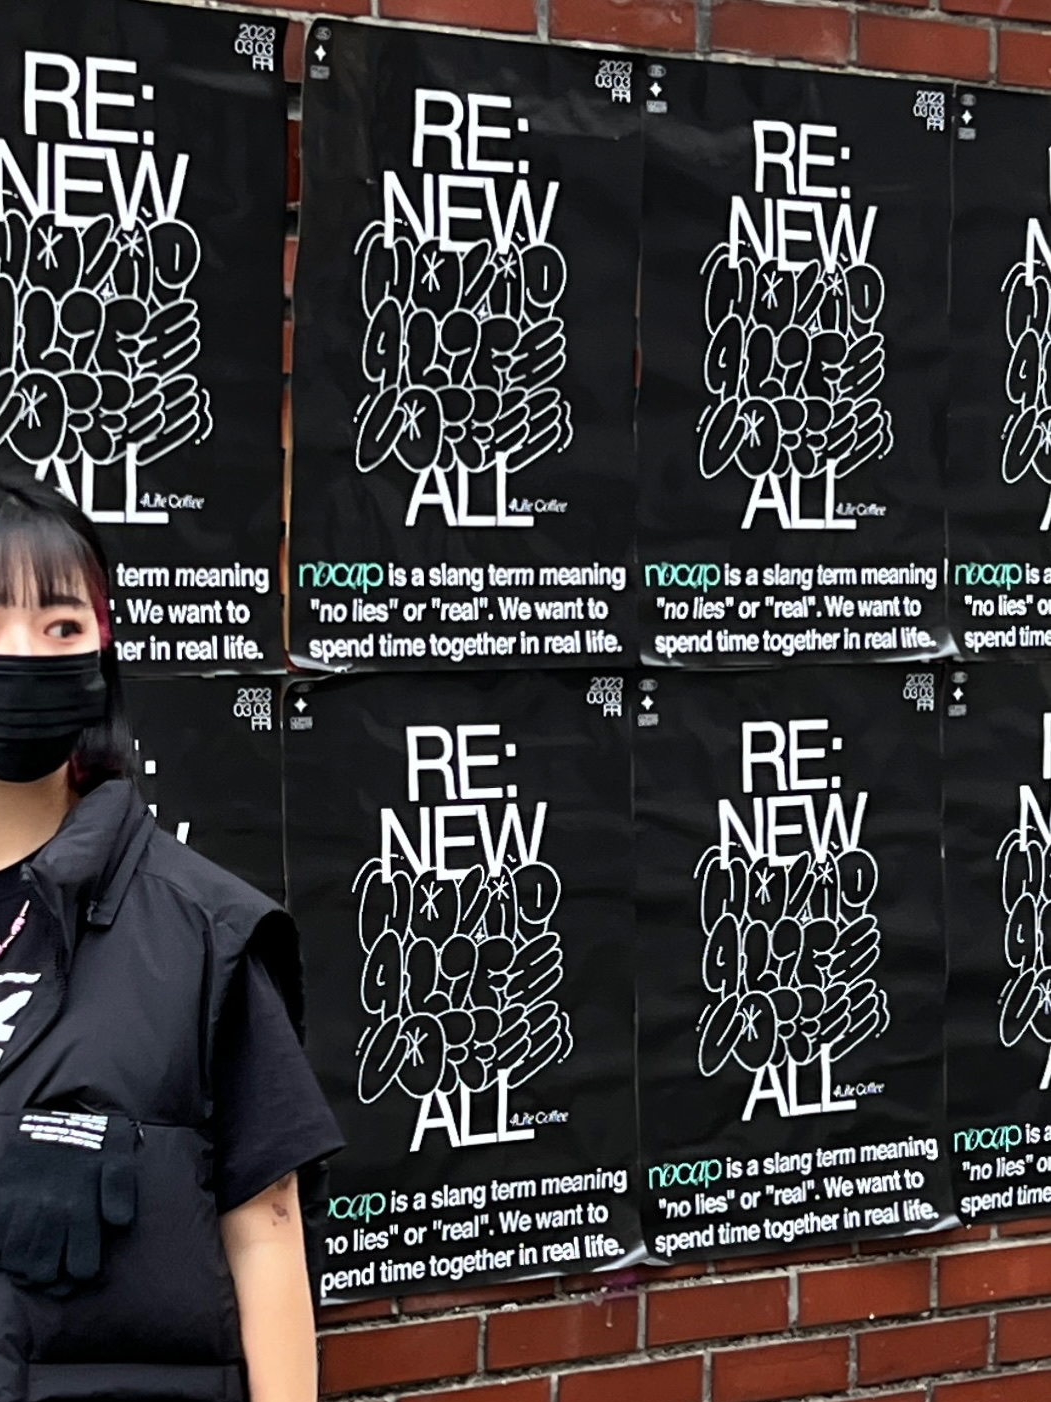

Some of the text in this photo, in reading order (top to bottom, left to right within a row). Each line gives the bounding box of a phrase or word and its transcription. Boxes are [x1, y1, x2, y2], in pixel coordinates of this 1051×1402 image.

[234, 38, 274, 56] 03 03
[239, 23, 276, 42] 2023
[23, 50, 154, 145] RE:
[412, 87, 529, 173] RE:
[753, 120, 850, 199] RE:
[382, 170, 559, 254] NEW
[728, 195, 877, 272] NEW
[405, 451, 534, 527] ALL
[741, 459, 856, 530] ALL
[115, 561, 270, 594] term meaning
[298, 561, 627, 595] nocap is a slang term meaning
[644, 562, 938, 593] nocap is a slang term meaning
[954, 562, 1023, 592] nocap
[125, 597, 252, 625] We want to
[310, 596, 609, 623] "no lies" or "real". We want to
[149, 634, 264, 661] in real life.
[309, 629, 623, 663] spend time together in real life.
[233, 702, 271, 717] 03 03
[237, 687, 272, 703] 2023
[406, 724, 518, 802] RE:
[741, 719, 843, 793] RE:
[380, 802, 547, 883] NEW
[719, 792, 868, 870] NEW
[410, 1068, 535, 1153] ALL
[742, 1044, 857, 1121] ALL
[658, 1168, 925, 1219] "no lies" or "real". We want to
[320, 1233, 626, 1297] pend time together in real life.
